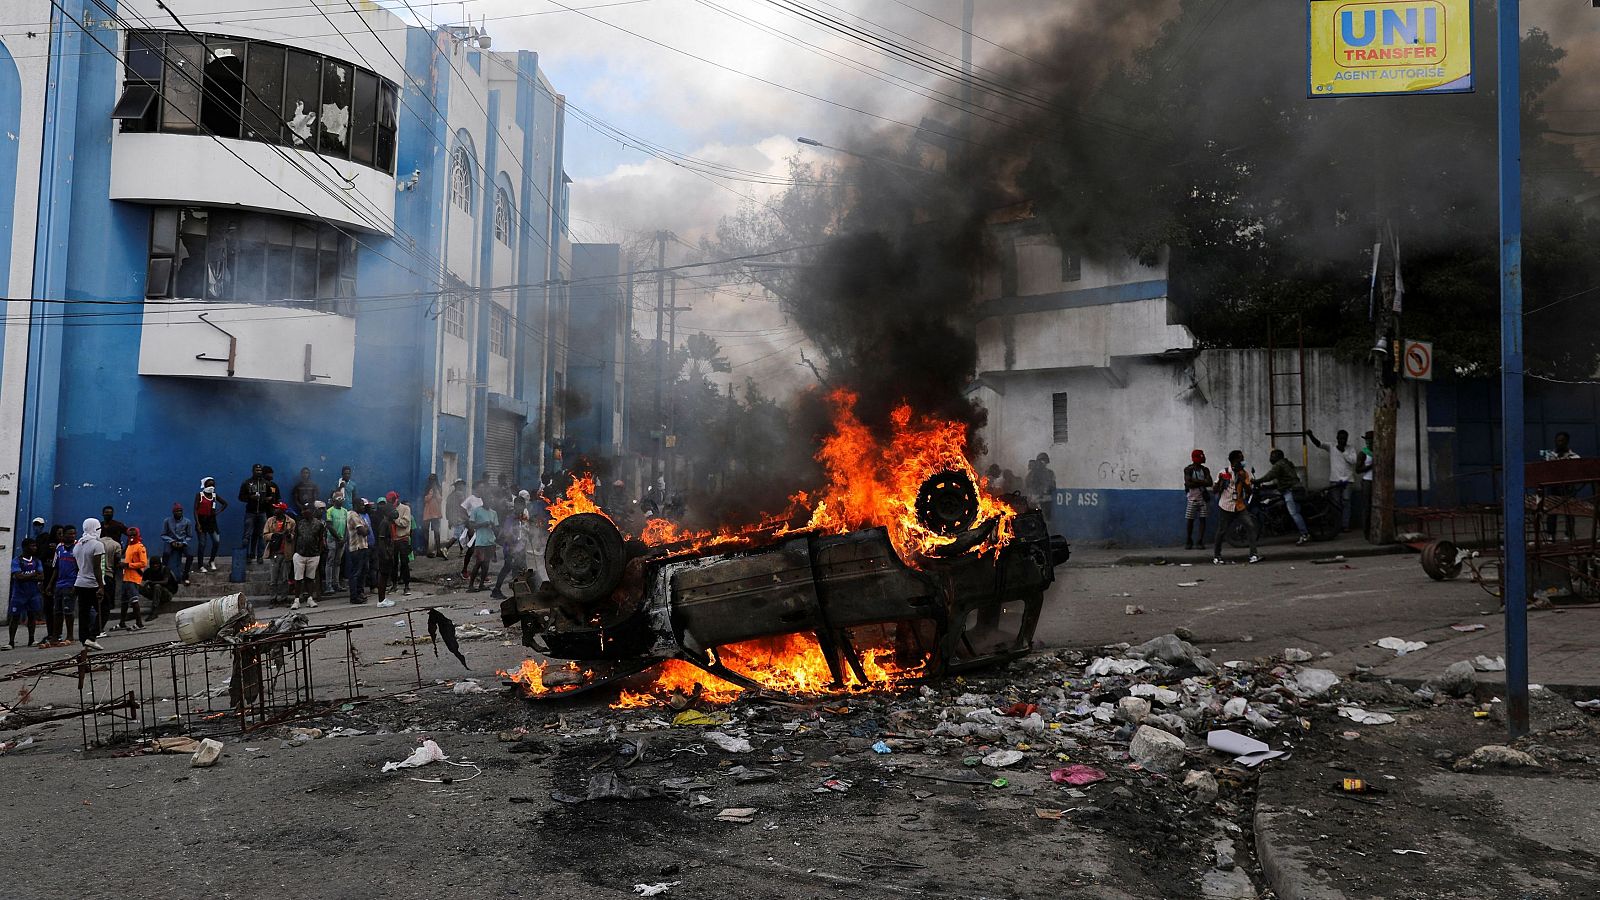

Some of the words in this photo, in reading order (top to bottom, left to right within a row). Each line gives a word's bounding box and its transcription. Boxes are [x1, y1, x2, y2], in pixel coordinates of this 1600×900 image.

[1341, 7, 1437, 47] UNI
[1344, 46, 1437, 61] TRANSFER
[1334, 70, 1377, 81] AGENT
[1380, 67, 1445, 80] AUTORISE
[1078, 492, 1098, 506] ASS
